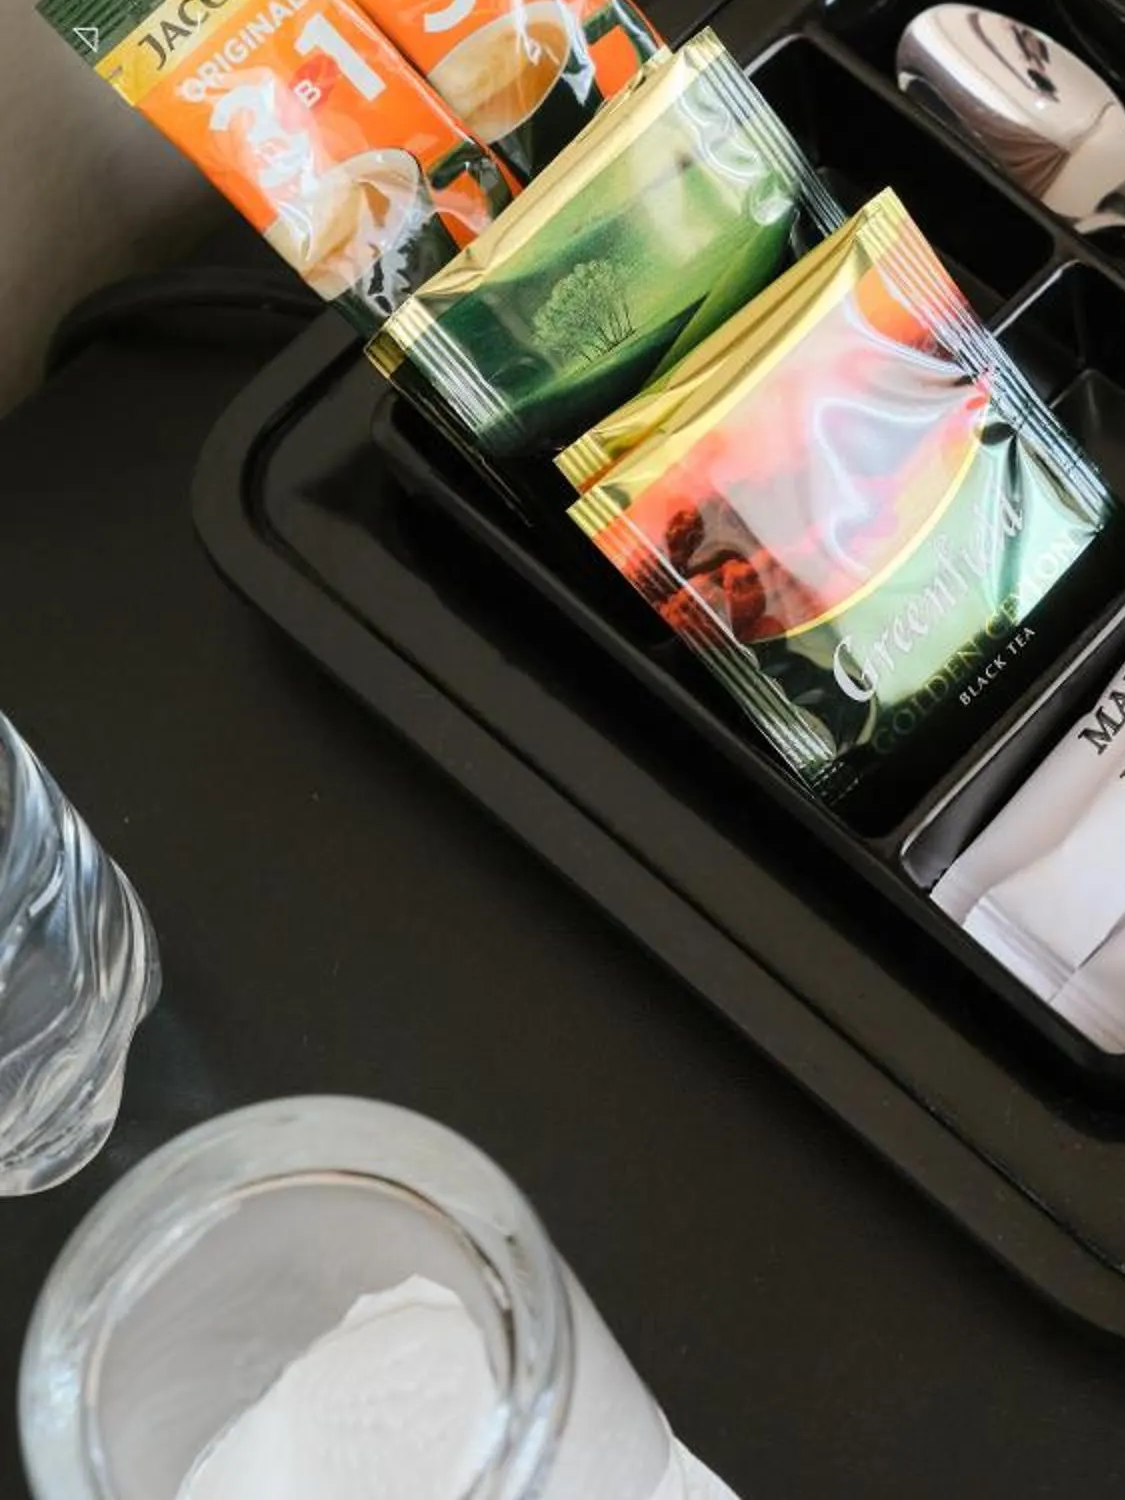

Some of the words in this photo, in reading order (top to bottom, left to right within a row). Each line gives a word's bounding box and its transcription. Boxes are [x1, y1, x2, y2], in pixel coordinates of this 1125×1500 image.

[294, 12, 386, 101] 1
[872, 635, 985, 754] GOLDEN
[959, 655, 1007, 706] BLACK
[1006, 627, 1036, 656] TEA
